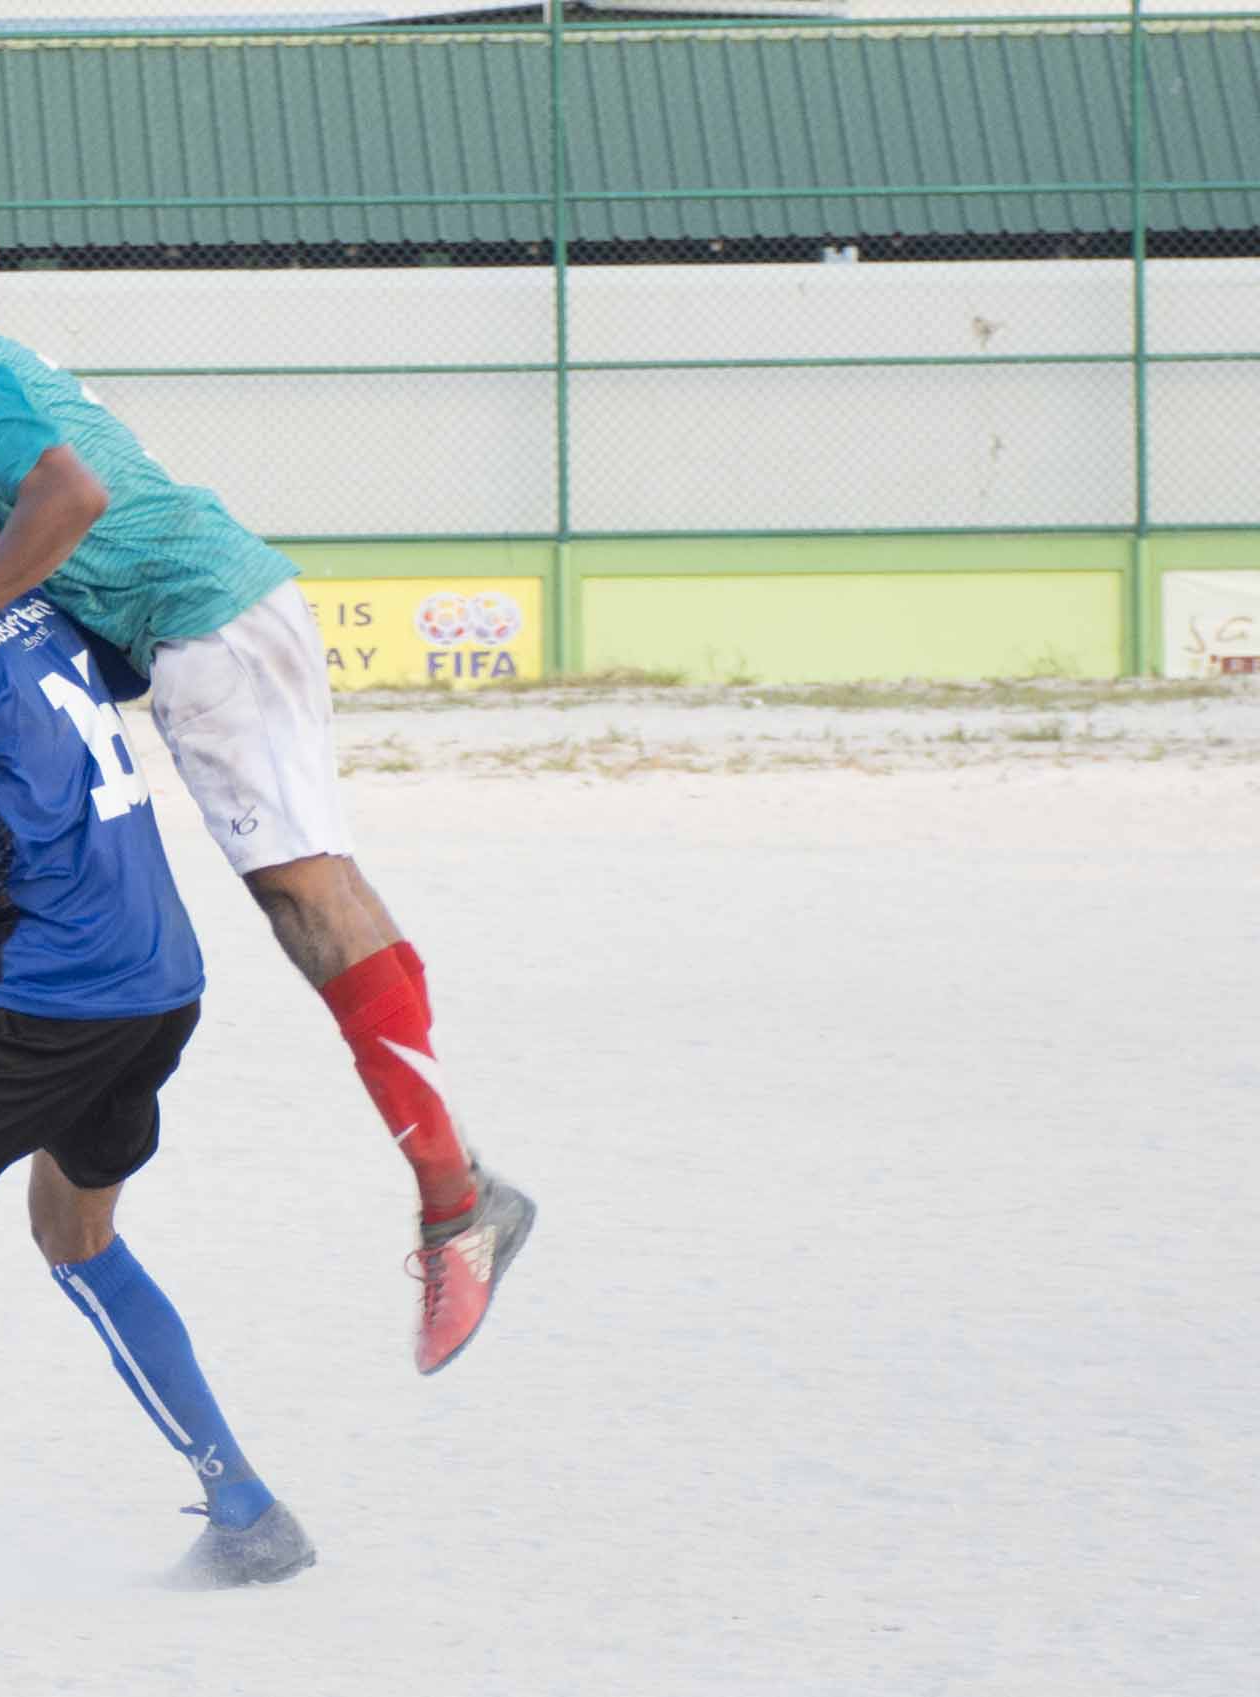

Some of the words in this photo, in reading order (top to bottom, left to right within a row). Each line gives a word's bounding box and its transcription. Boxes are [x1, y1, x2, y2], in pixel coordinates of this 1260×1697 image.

[339, 603, 373, 626] IS
[326, 647, 379, 671] AY
[427, 651, 517, 678] FIFA
